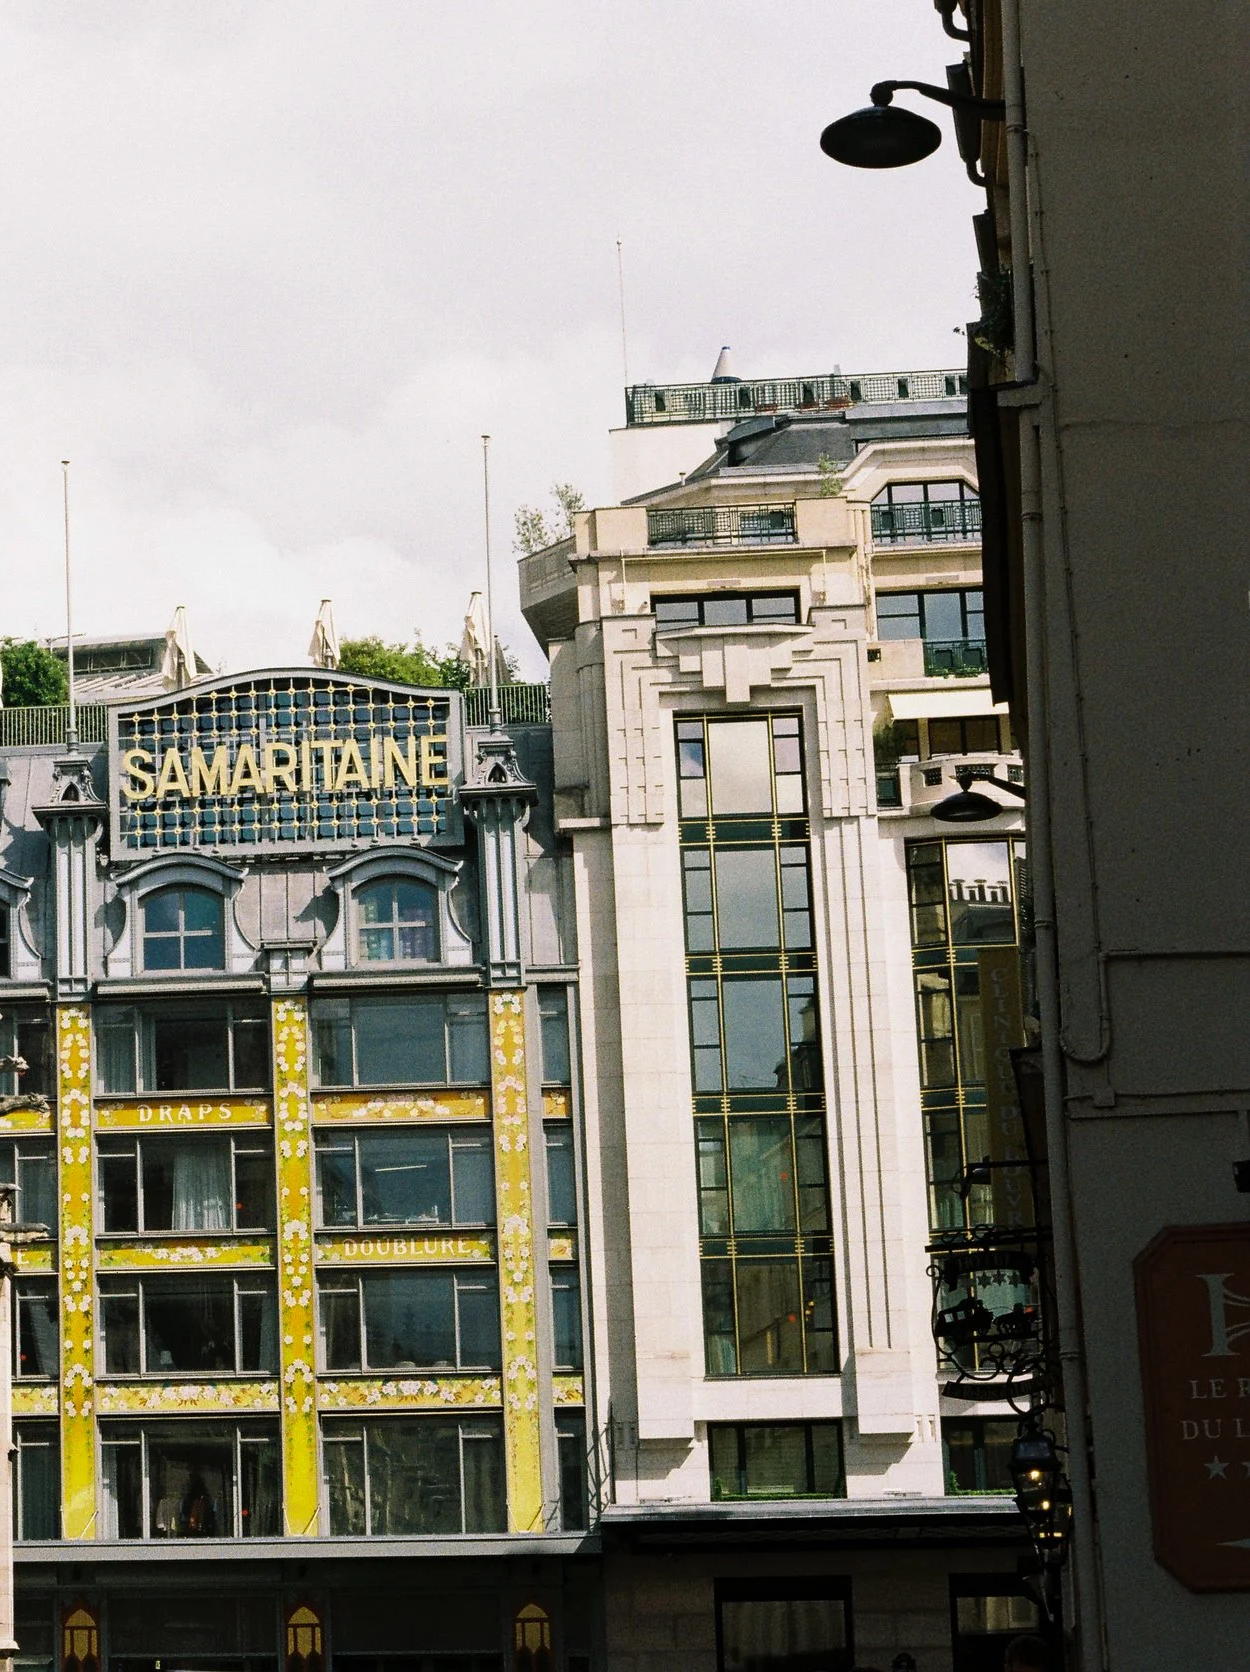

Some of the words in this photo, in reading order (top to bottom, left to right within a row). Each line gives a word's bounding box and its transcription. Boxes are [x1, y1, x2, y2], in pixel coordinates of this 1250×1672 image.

[121, 735, 449, 801] SAMARITAINE
[137, 1102, 233, 1123] DRAPS
[1001, 1146, 1024, 1230] LOUVR
[342, 1236, 472, 1257] DOUBLURE
[1189, 1378, 1227, 1399] LE
[1180, 1418, 1222, 1440] DU
